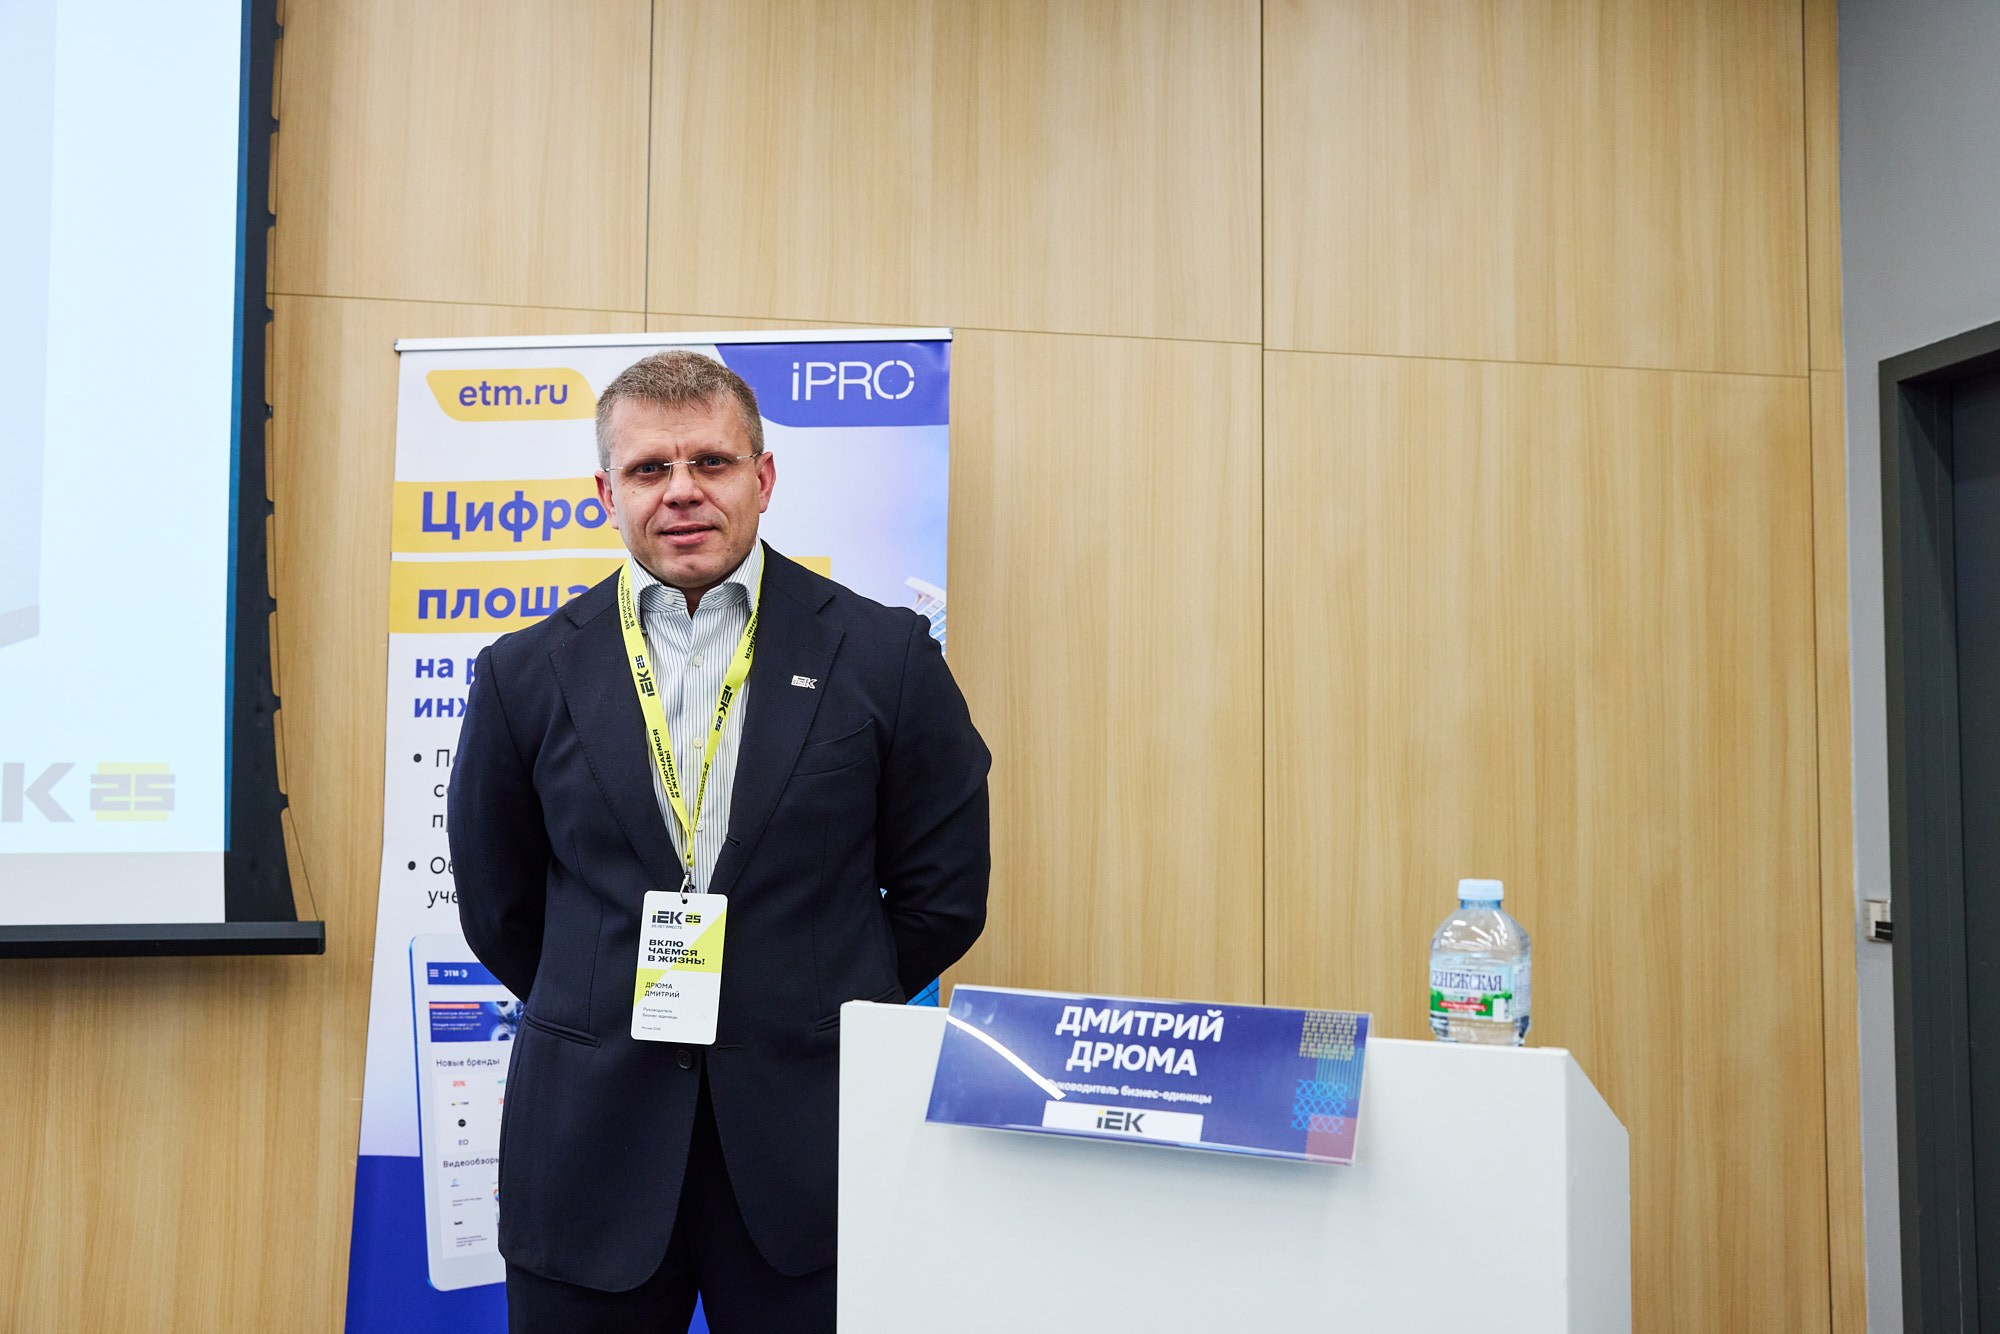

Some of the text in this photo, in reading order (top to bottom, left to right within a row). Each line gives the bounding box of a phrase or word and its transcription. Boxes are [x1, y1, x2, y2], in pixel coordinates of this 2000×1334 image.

[791, 360, 915, 402] iPRO
[458, 381, 568, 408] etm.ru
[422, 491, 608, 542] Цифро
[415, 658, 454, 679] на
[653, 729, 675, 798] ВКЛЮЧАЕМСЯ
[664, 750, 678, 790] ЖИЗНЬ!
[90, 774, 176, 811] 25
[685, 914, 702, 924] 25
[648, 947, 698, 956] ЧАЕМСЯ
[649, 939, 684, 948] ВКЛЮ
[658, 956, 705, 965] ЖИЗНЬ!
[644, 990, 680, 998] ДМИТРИЙ
[645, 981, 673, 989] ДРЮМА
[1055, 1005, 1225, 1043] ДМИТРИЙ
[436, 1056, 500, 1067] Новые бренды
[1066, 1040, 1198, 1077] ДРЮМА
[1121, 1085, 1212, 1104] бизнес-единицы
[1096, 1109, 1146, 1133] iEK
